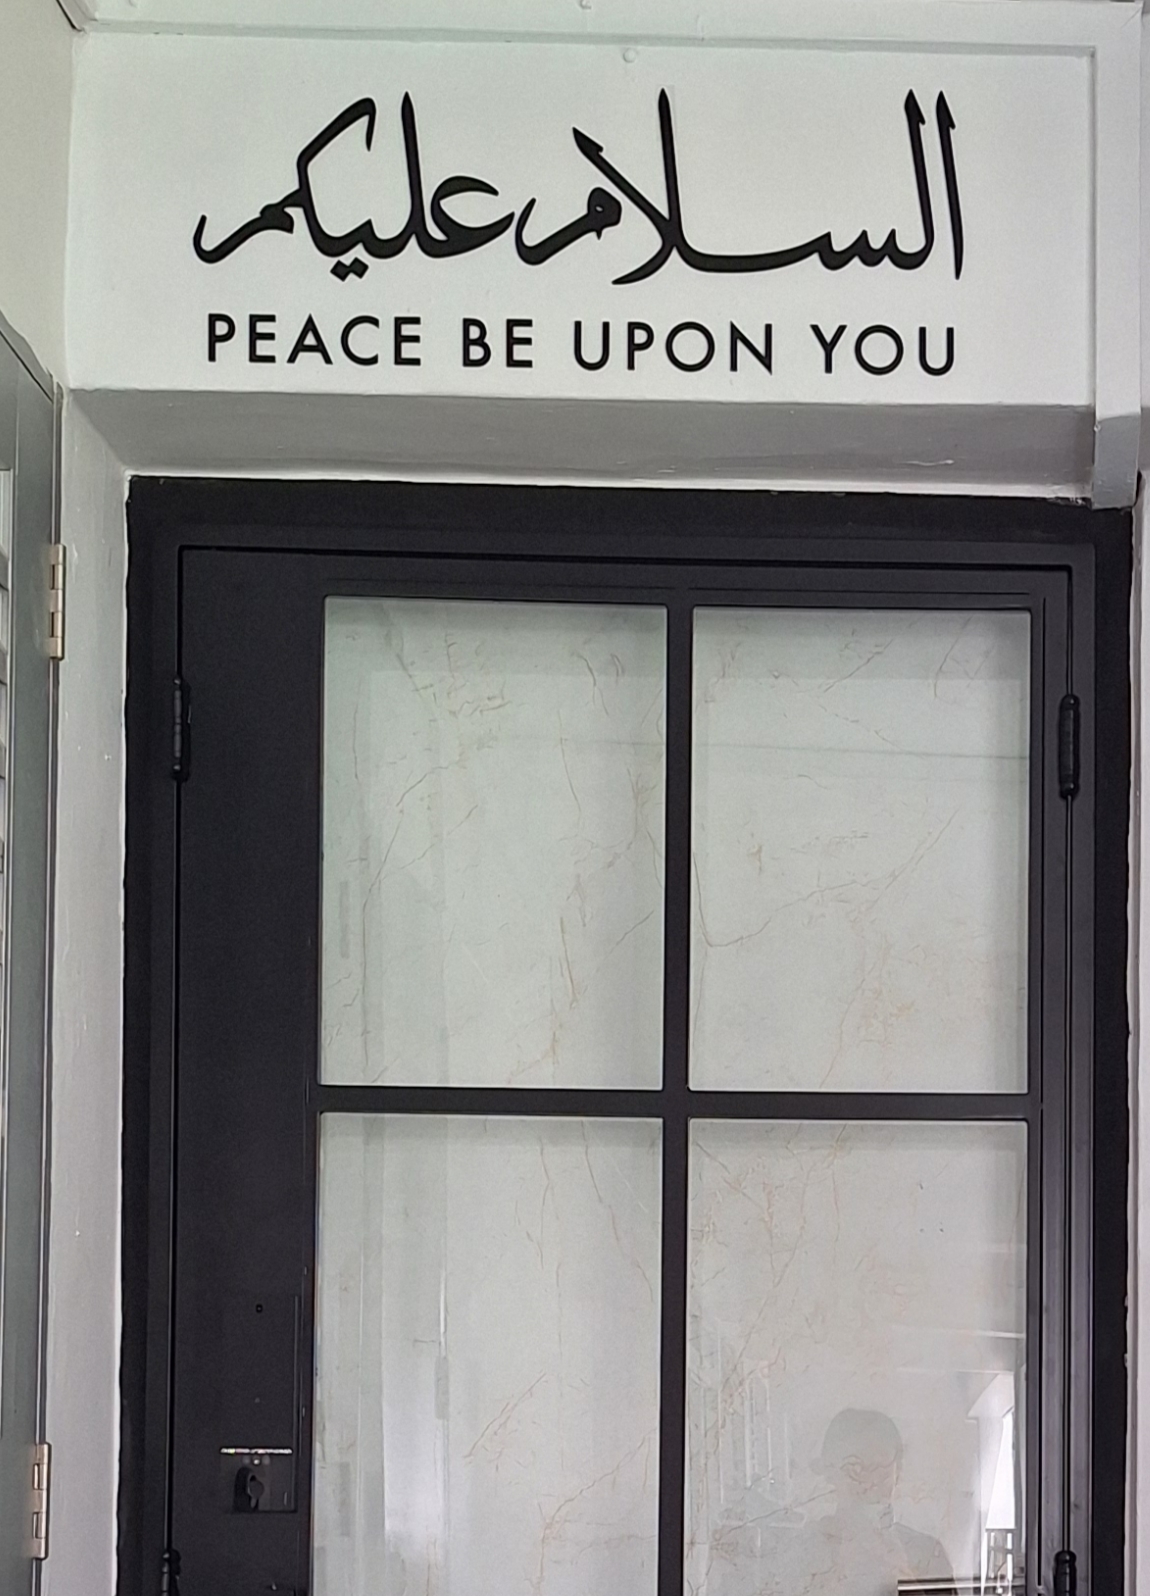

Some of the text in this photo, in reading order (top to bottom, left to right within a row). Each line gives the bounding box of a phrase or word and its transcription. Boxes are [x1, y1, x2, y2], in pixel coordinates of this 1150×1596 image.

[193, 88, 965, 285] السلام عليكم
[206, 313, 956, 376] PEACE BE UPON YOU
